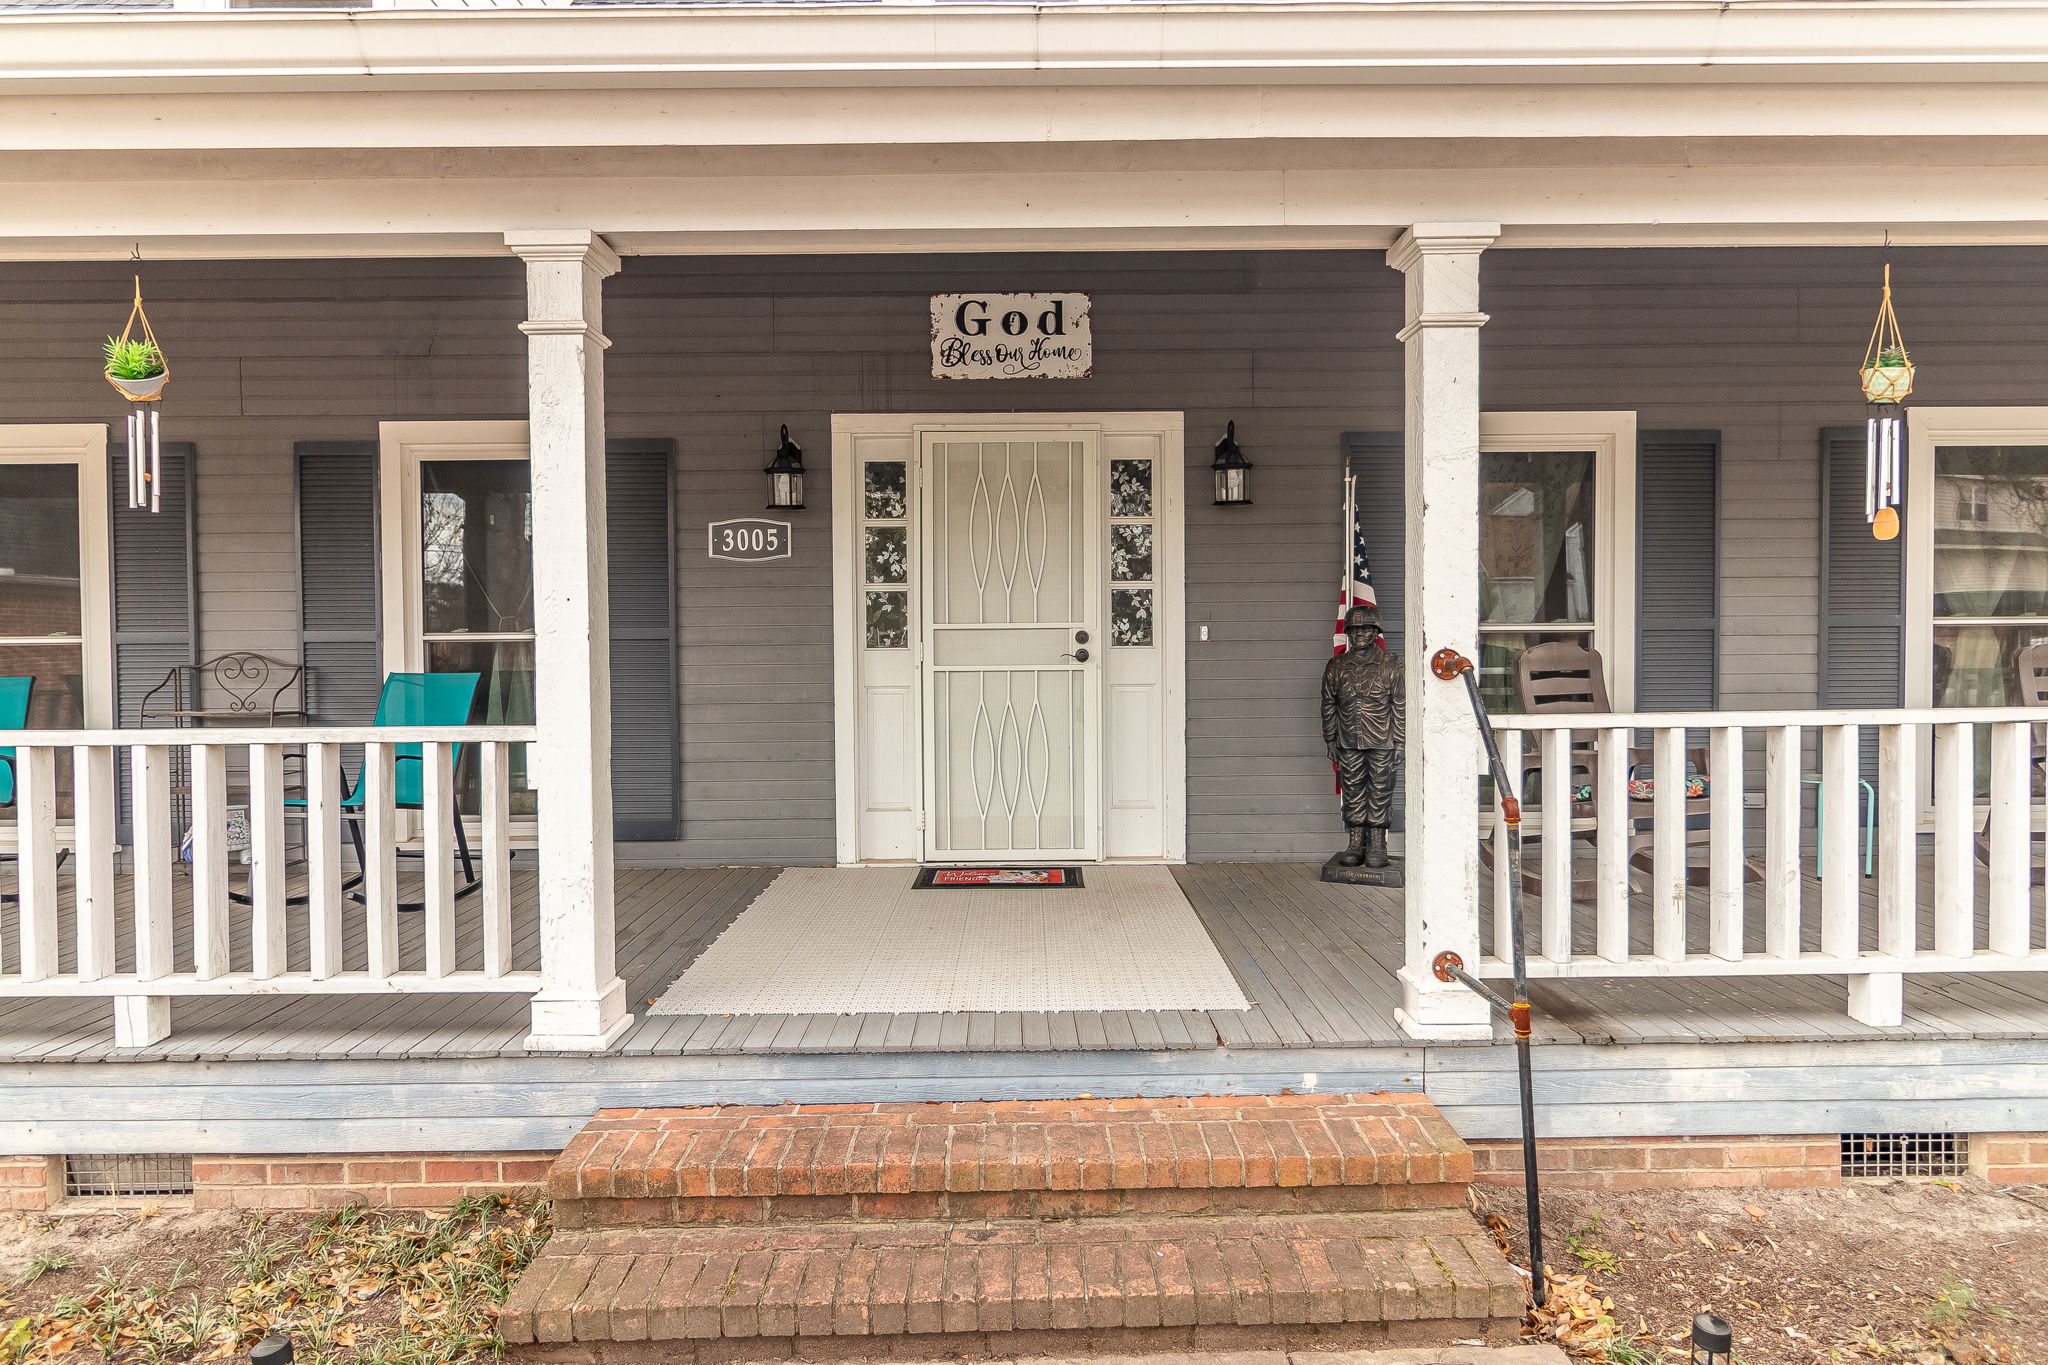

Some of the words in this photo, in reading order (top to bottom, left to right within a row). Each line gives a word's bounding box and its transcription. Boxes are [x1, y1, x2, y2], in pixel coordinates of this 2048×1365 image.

[955, 300, 1067, 336] God
[940, 337, 993, 367] Bless
[995, 343, 1041, 375] Our
[1028, 337, 1082, 362] Home
[722, 528, 779, 552] 3005
